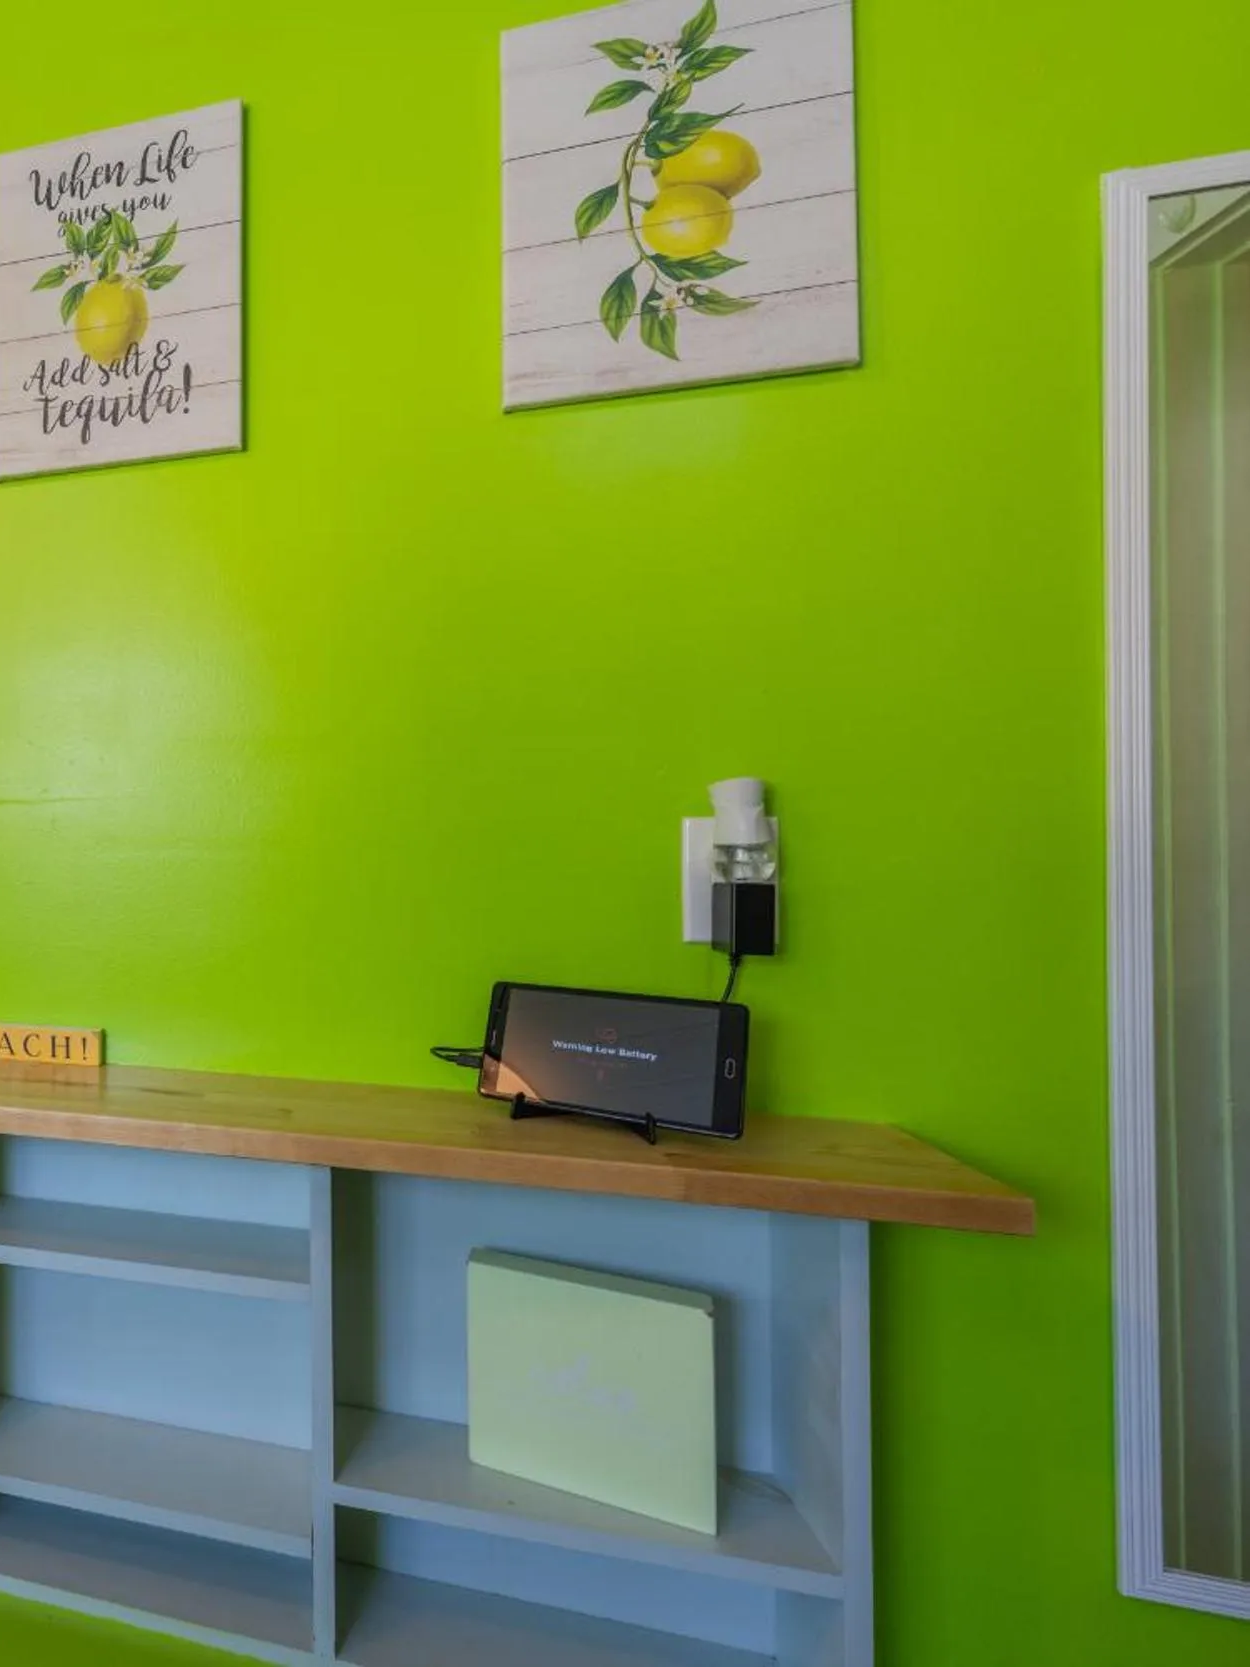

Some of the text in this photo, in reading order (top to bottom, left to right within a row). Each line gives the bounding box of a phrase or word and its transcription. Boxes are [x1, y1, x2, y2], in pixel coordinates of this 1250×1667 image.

[29, 130, 199, 211] When Life
[123, 192, 172, 223] you
[23, 353, 95, 396] Add
[153, 339, 180, 372] &
[552, 1039, 593, 1054] Warning
[596, 1044, 616, 1055] Low
[619, 1047, 658, 1062] Battery
